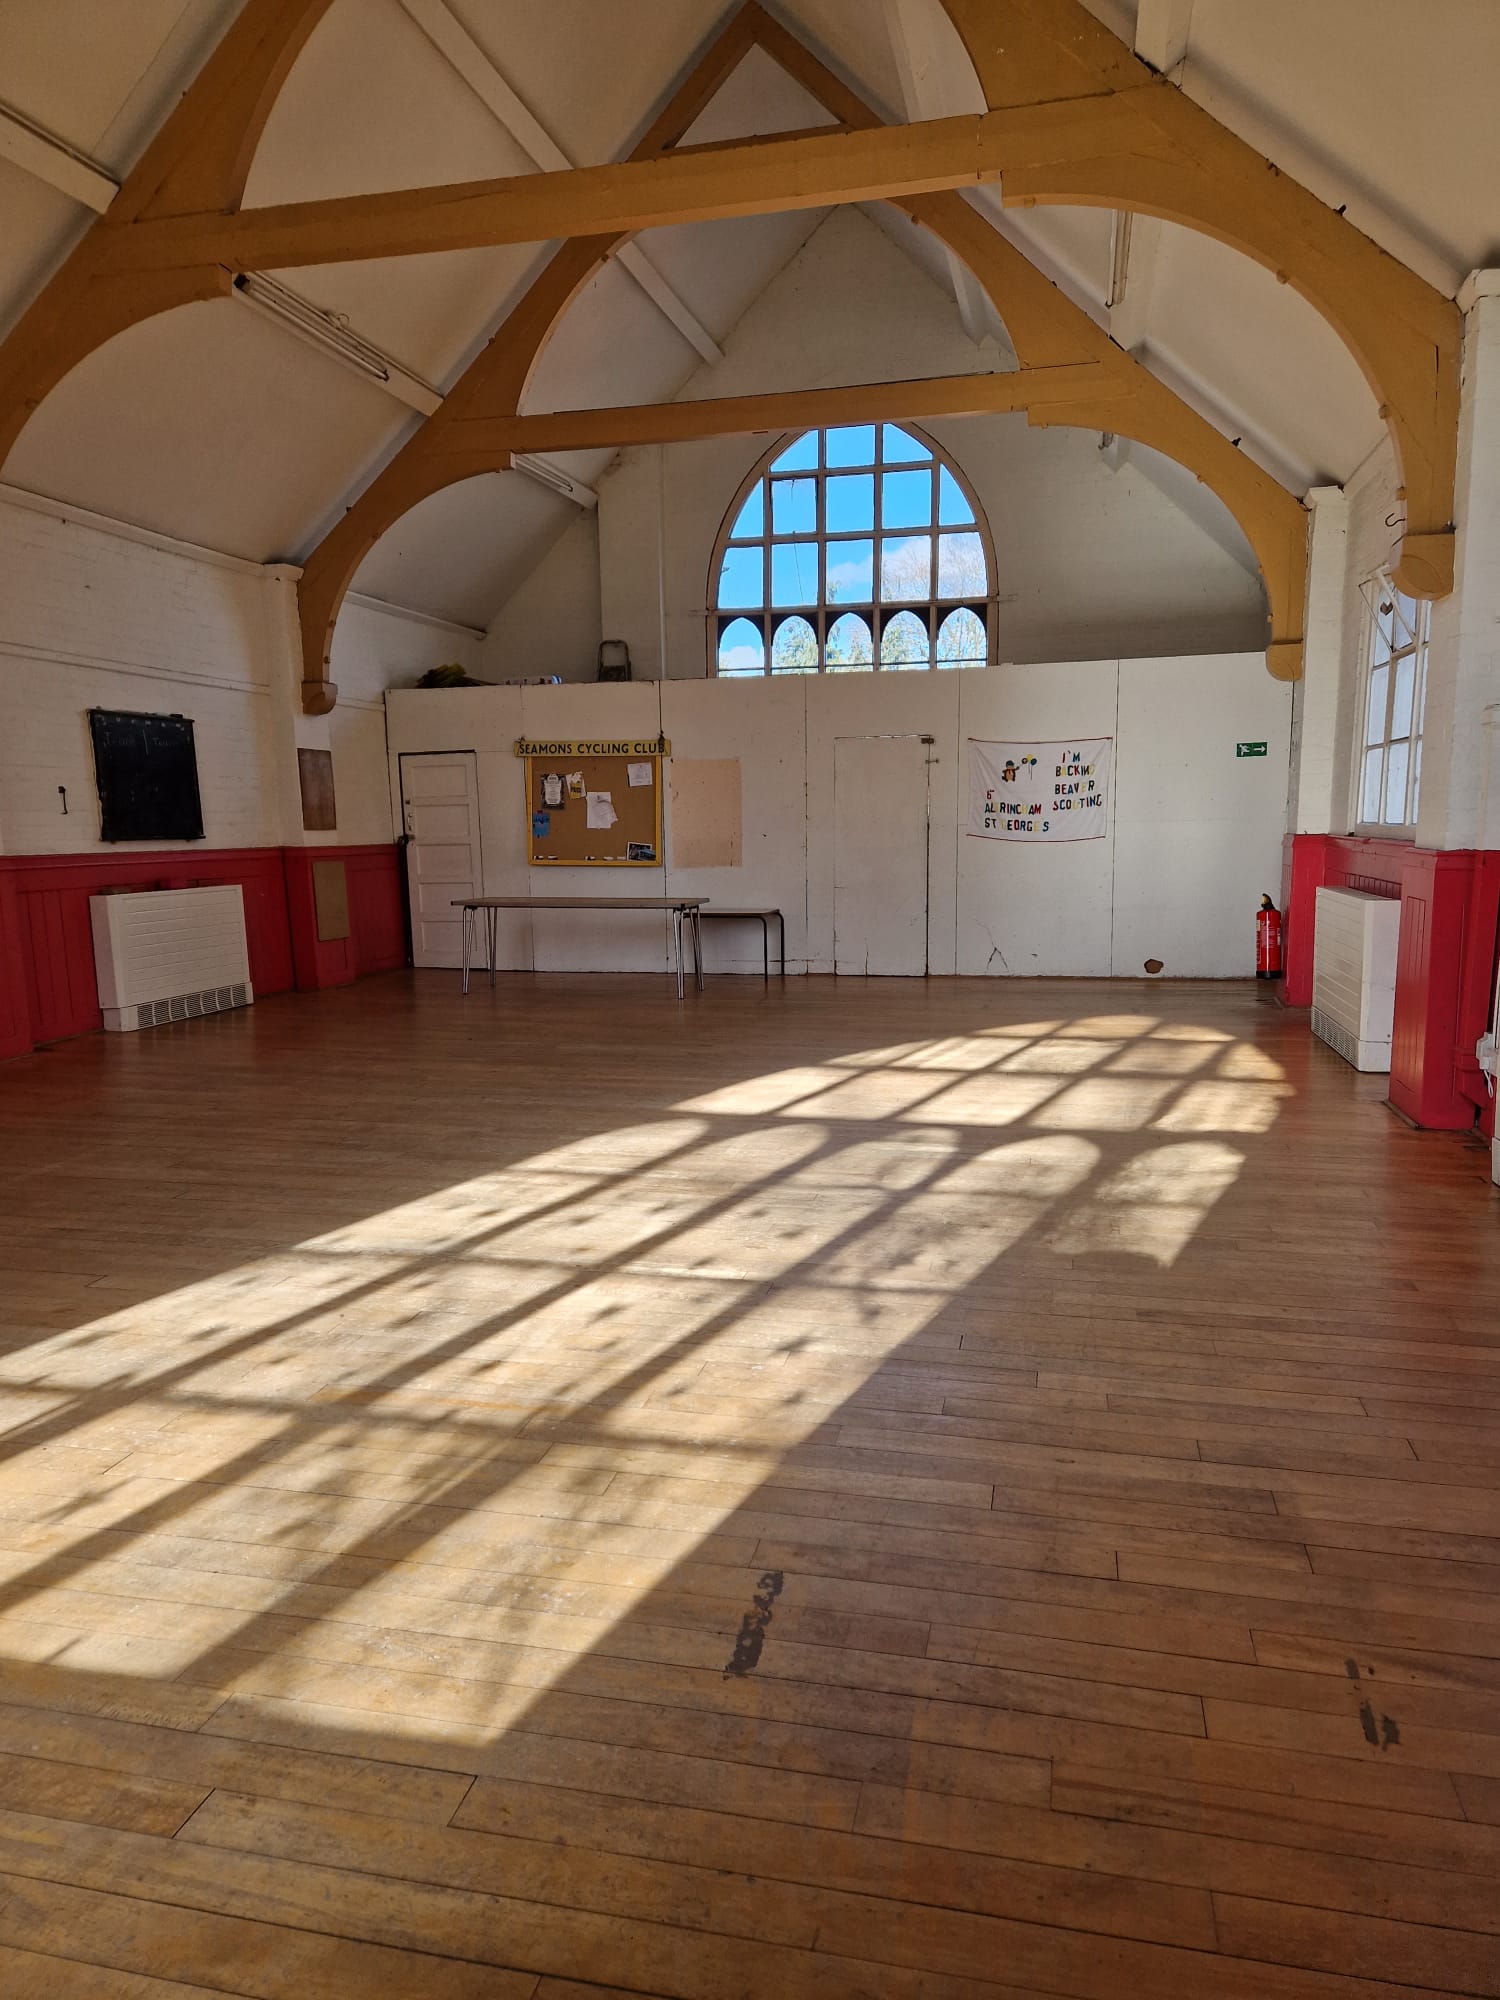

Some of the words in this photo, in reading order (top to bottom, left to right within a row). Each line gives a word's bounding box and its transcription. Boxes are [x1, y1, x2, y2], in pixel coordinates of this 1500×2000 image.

[519, 743, 572, 754] SEAMONS
[577, 743, 629, 754] CYCLING
[634, 743, 665, 754] CLUB
[1054, 780, 1095, 795] BEAVER
[984, 817, 997, 829] ST
